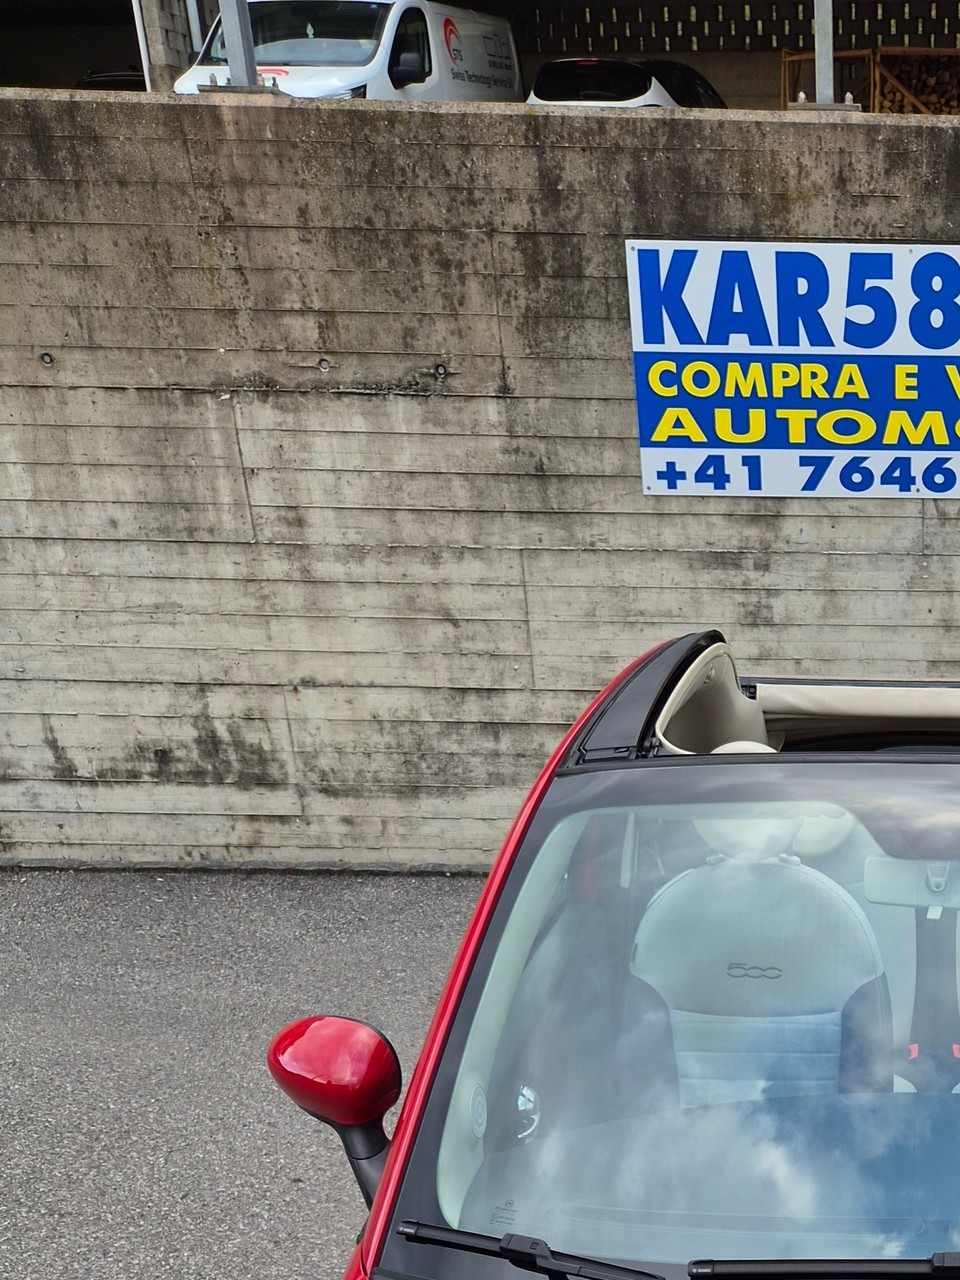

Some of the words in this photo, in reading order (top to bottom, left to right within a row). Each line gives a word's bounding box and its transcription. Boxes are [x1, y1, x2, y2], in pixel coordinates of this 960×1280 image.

[648, 360, 869, 399] COMPRA
[895, 364, 919, 400] E
[656, 454, 762, 491] +41
[726, 963, 783, 979] 500
